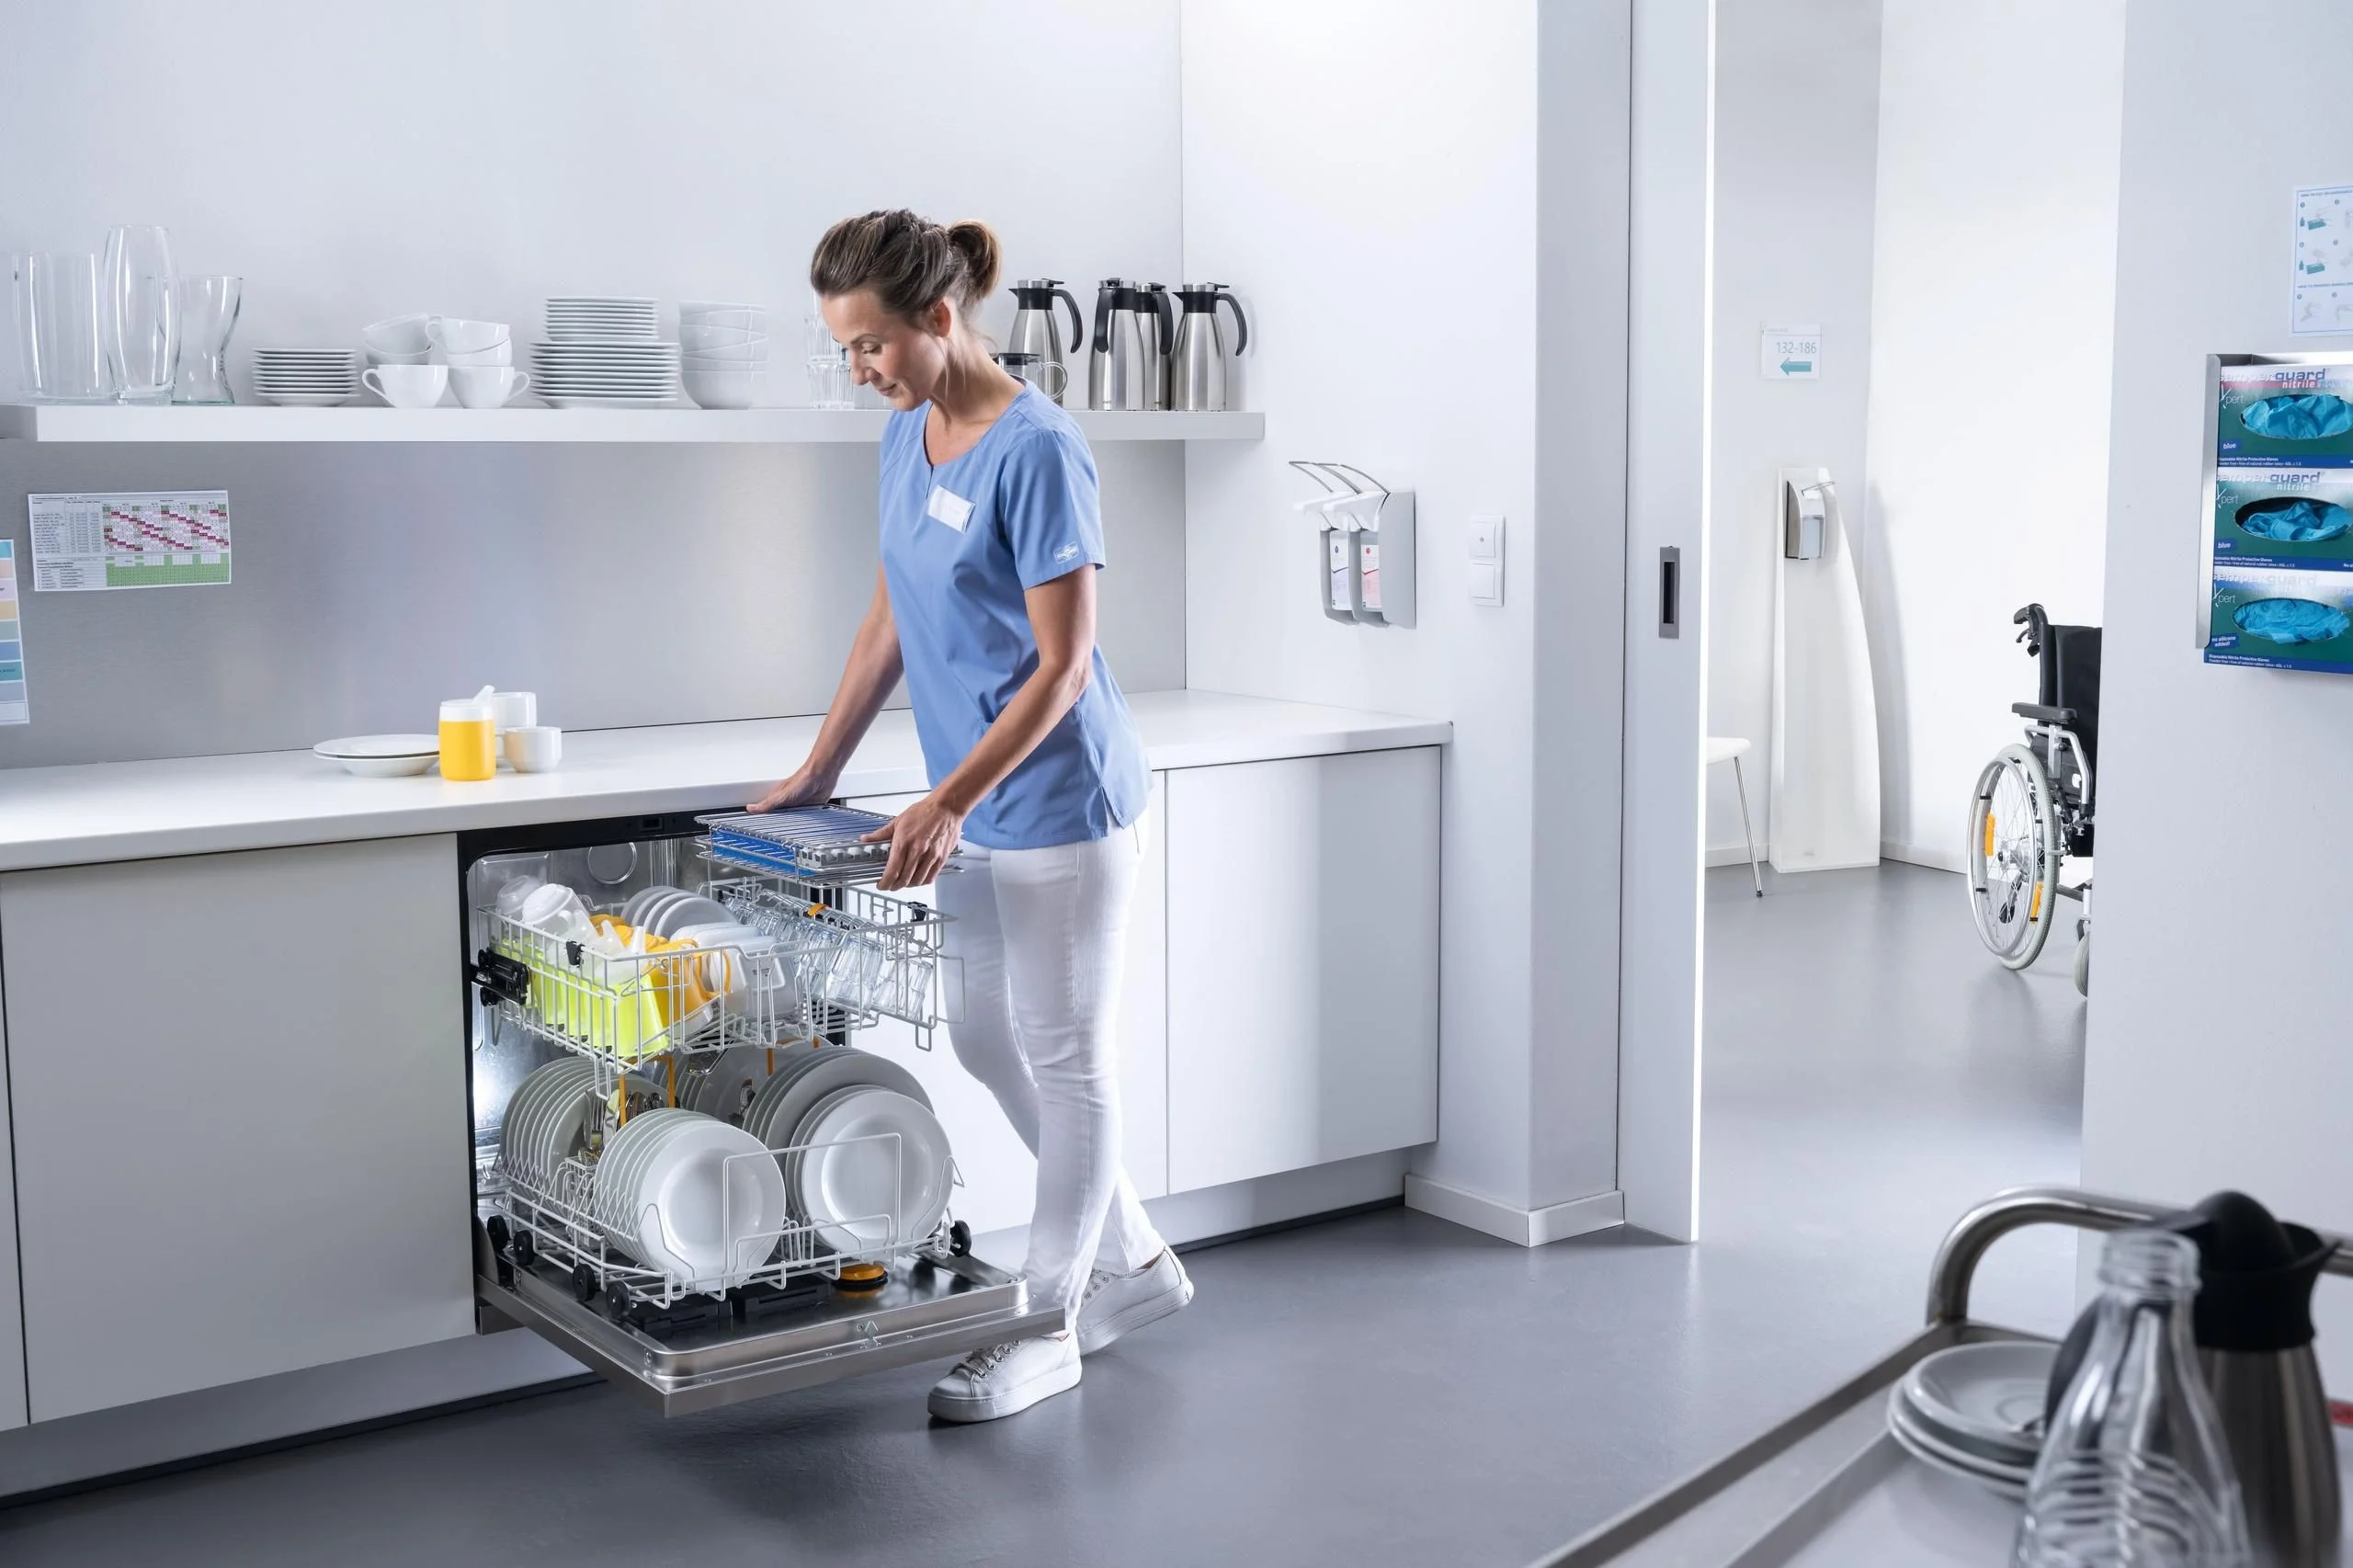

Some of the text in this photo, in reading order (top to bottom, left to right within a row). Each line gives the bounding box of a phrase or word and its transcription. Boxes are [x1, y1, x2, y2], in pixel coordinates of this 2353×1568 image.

[1776, 341, 1817, 354] 132-186
[2282, 379, 2315, 389] nitrile
[2277, 482, 2310, 492] nitrile
